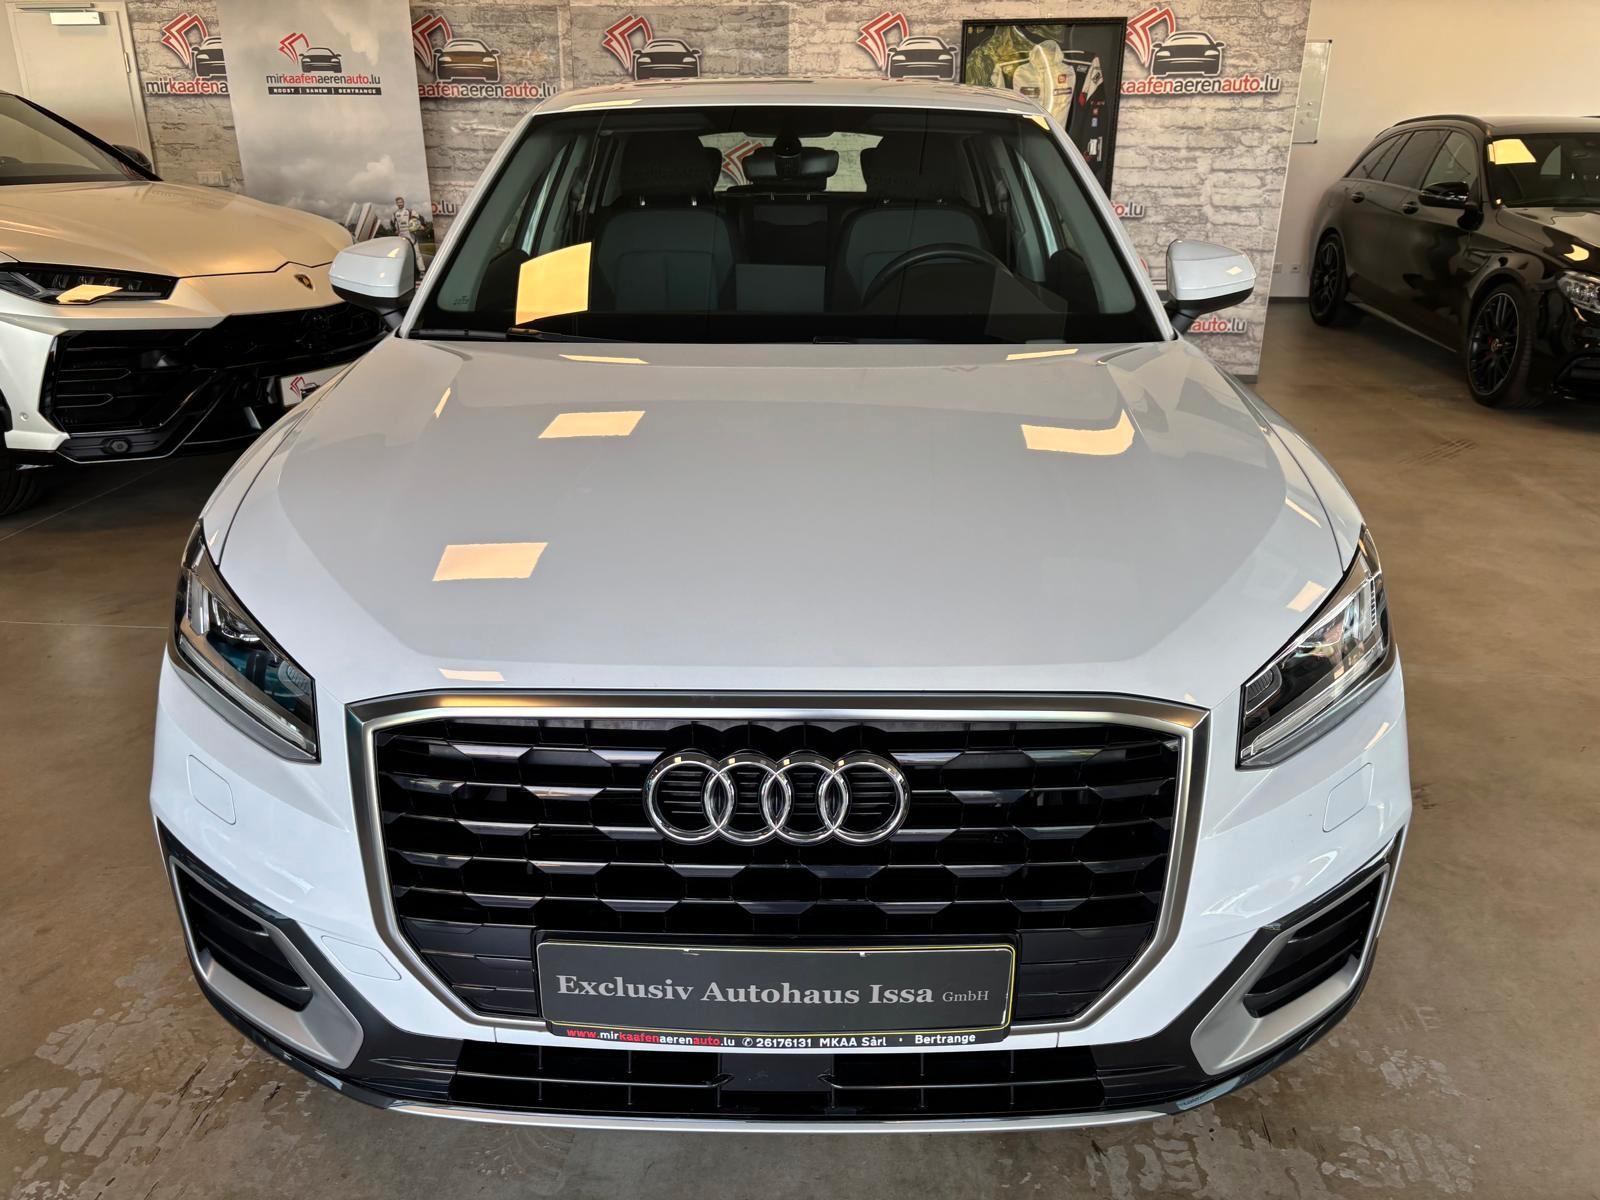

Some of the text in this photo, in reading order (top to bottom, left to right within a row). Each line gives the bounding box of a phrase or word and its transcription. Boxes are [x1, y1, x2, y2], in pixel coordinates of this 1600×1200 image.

[266, 73, 381, 85] mirkaafenaerenauto.lu
[556, 975, 989, 1004] Exclusiv Autohaus Issa GmbH
[566, 1028, 735, 1046] www.mirkaafenaerenauto.lu
[756, 1037, 812, 1048] 26176131
[819, 1037, 858, 1047] MKAA
[915, 1034, 976, 1045] Bertrange
